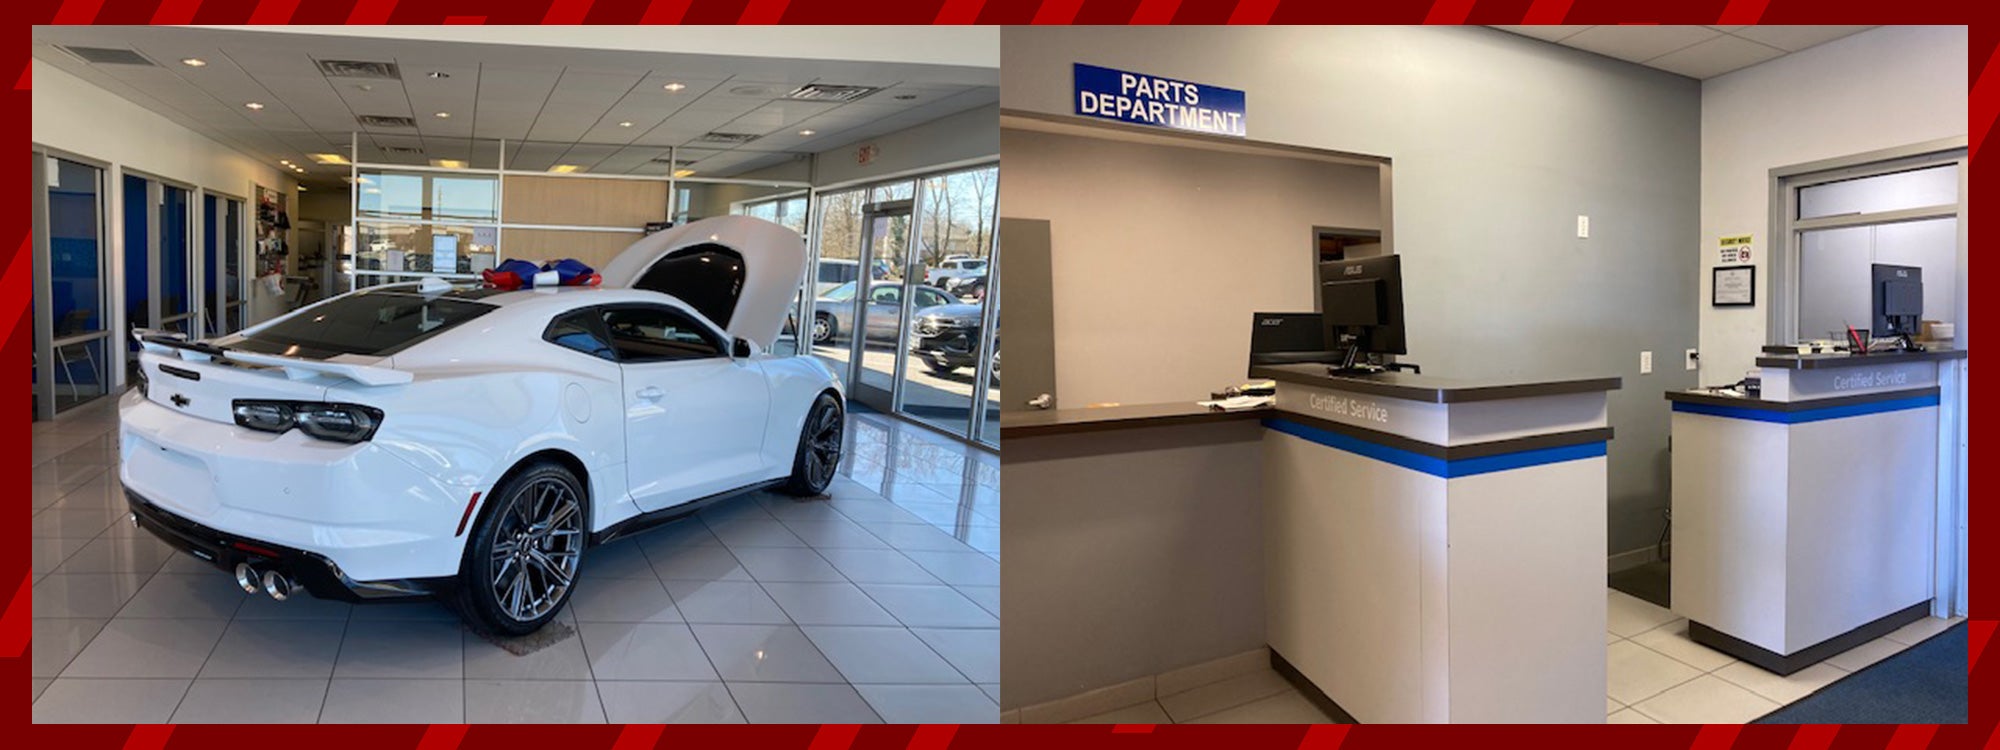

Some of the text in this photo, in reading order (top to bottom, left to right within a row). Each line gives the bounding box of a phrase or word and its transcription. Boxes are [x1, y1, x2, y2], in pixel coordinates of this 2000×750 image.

[1121, 73, 1199, 105] PARTS
[1080, 91, 1241, 133] DEPARTMENT
[1344, 265, 1363, 275] ASUS
[1834, 371, 1906, 390] Certified Service
[1310, 393, 1388, 423] Certified Service
